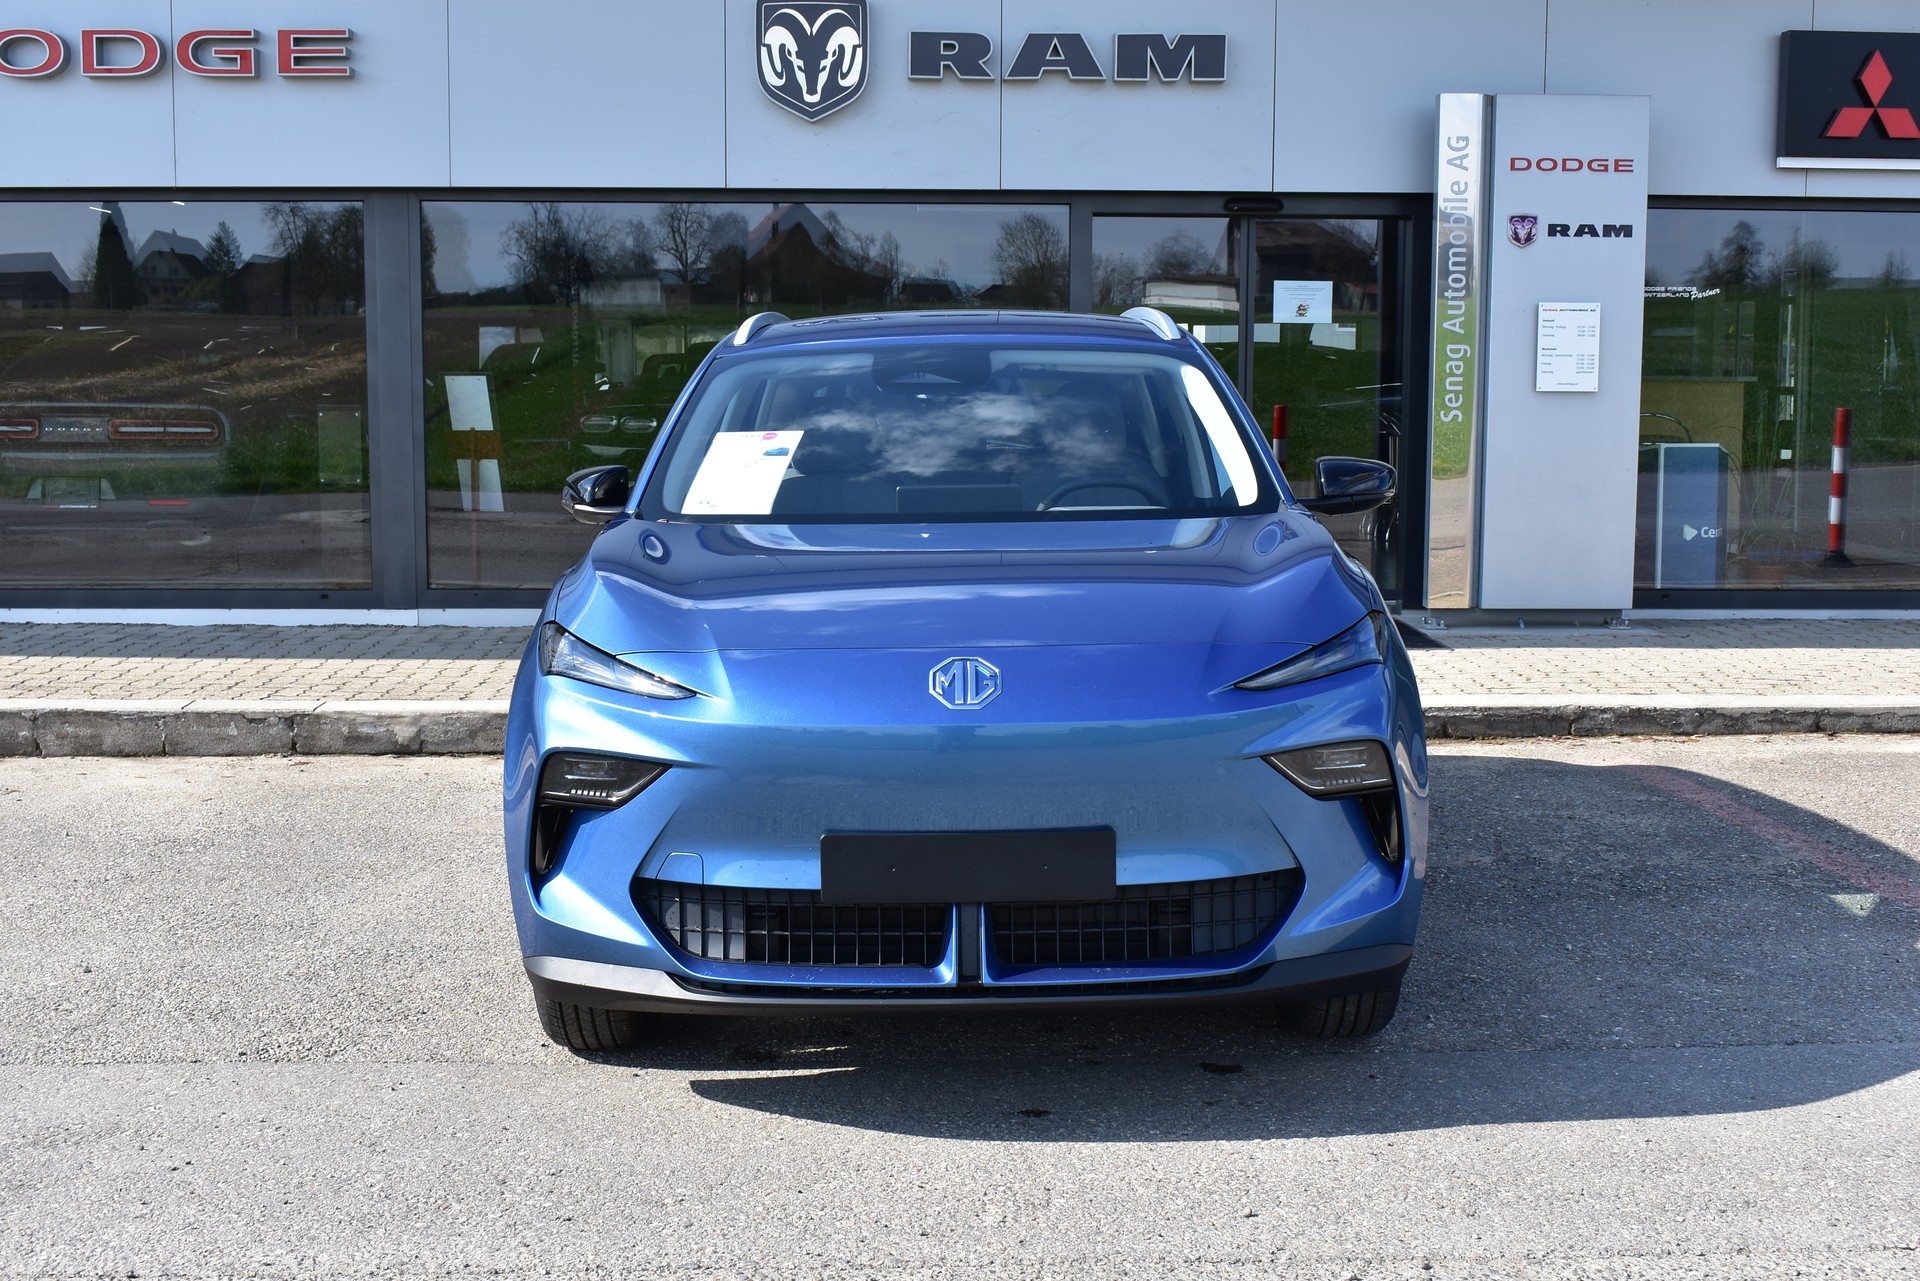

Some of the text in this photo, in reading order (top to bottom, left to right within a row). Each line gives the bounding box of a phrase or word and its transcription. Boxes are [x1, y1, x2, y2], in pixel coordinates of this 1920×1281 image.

[908, 31, 1227, 82] RAM
[1510, 157, 1634, 173] DODGE
[1547, 223, 1633, 238] RAM
[1440, 135, 1470, 422] Senag Automobile AG
[1690, 288, 1720, 300] Partner
[932, 658, 999, 707] MG
